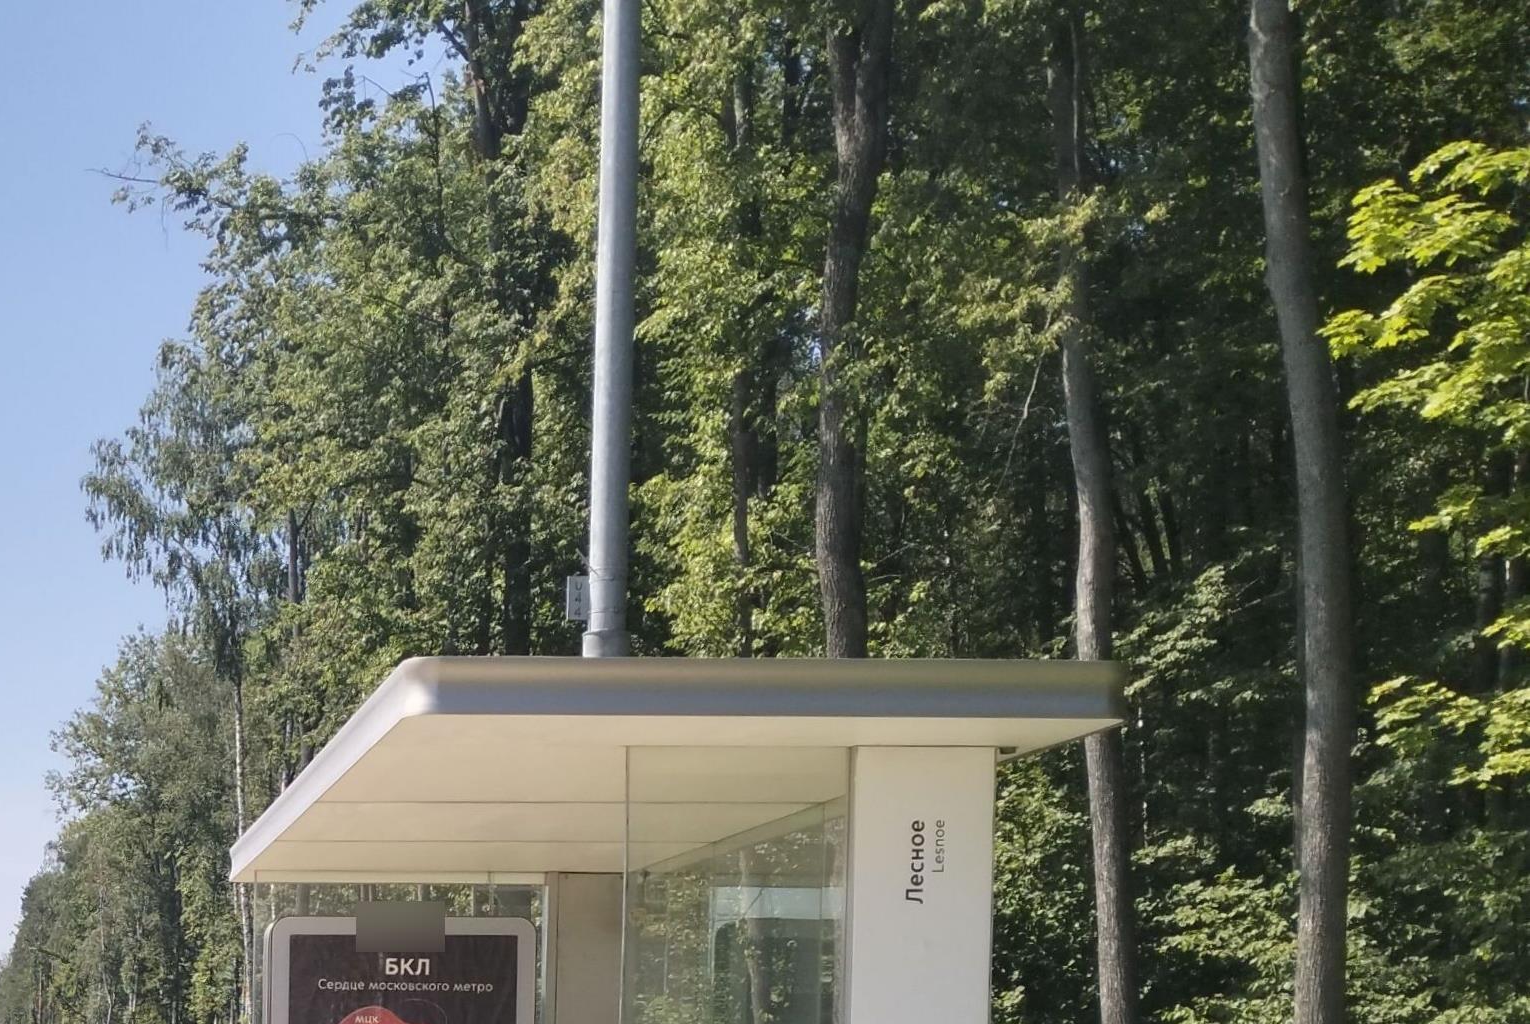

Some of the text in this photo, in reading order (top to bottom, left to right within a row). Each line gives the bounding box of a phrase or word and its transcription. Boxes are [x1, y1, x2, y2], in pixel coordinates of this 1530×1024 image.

[905, 820, 925, 904] Лесное
[931, 819, 946, 873] Lesnoe
[384, 957, 431, 976] БКЛ
[317, 978, 494, 994] Сердце московского метро
